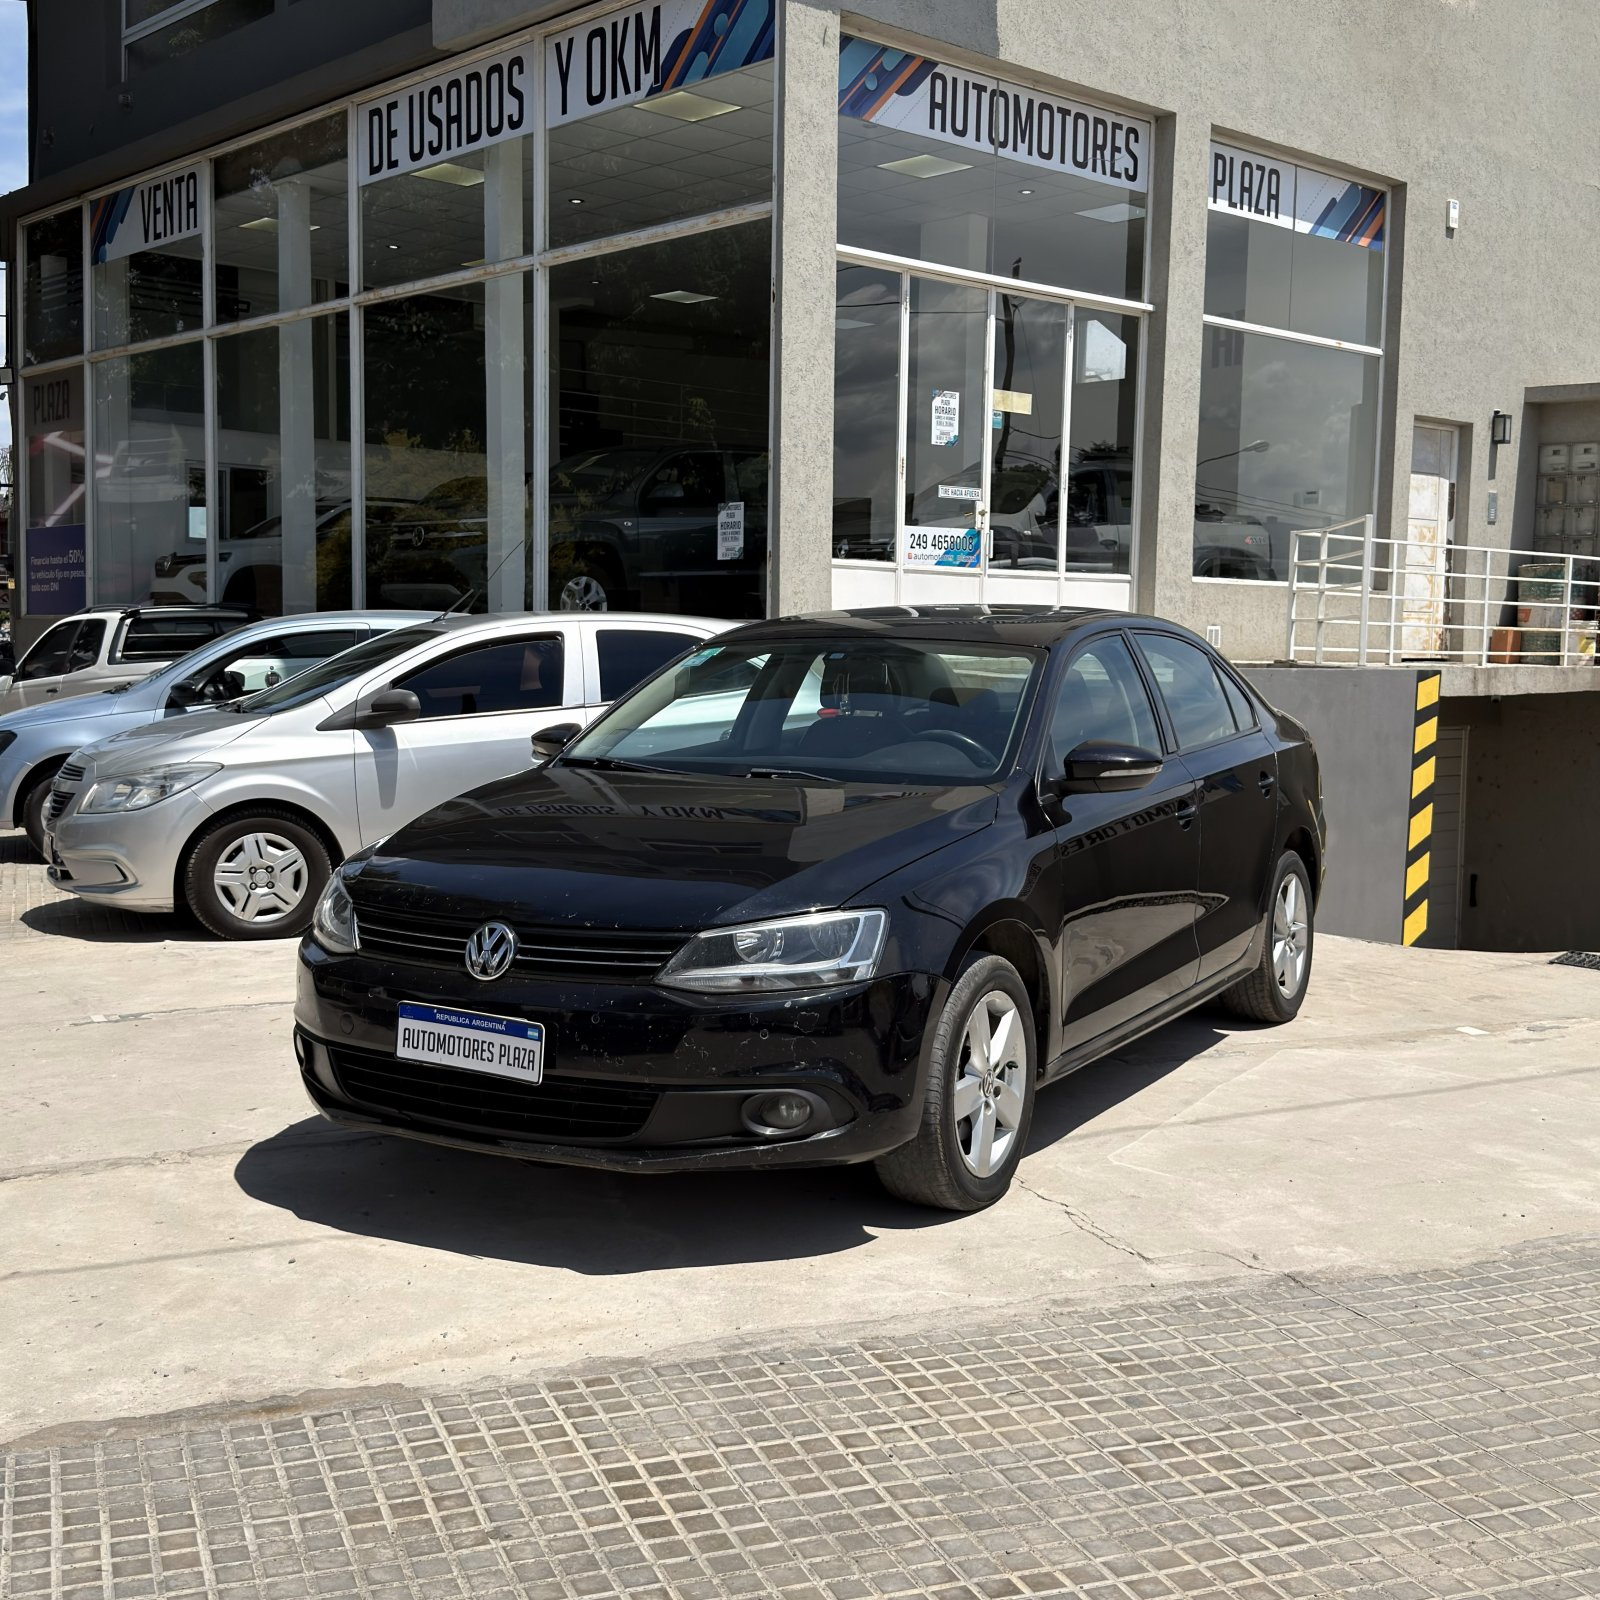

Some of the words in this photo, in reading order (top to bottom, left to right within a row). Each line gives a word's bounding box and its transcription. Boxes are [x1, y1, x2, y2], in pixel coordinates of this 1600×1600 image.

[369, 100, 399, 176] DE
[408, 55, 524, 162] USADOS
[554, 37, 574, 116] Y
[929, 72, 1139, 183] AUTOMOTORES
[1213, 152, 1281, 219] PLAZA
[141, 172, 197, 244] VENTA
[33, 379, 70, 425] PLAZA
[934, 406, 956, 416] HORARIO
[940, 487, 950, 496] TIRE
[950, 488, 963, 497] HACIA
[963, 489, 980, 498] AFUERA
[720, 520, 741, 530] HORARIO
[910, 533, 928, 549] 249
[931, 534, 974, 551] 4658008
[69, 549, 85, 564] 50%
[436, 1013, 470, 1025] REPUBLICA
[471, 1019, 506, 1031] ARGENTINA
[402, 1027, 494, 1063] AUTOMOTORES
[499, 1043, 536, 1072] PLAZA
